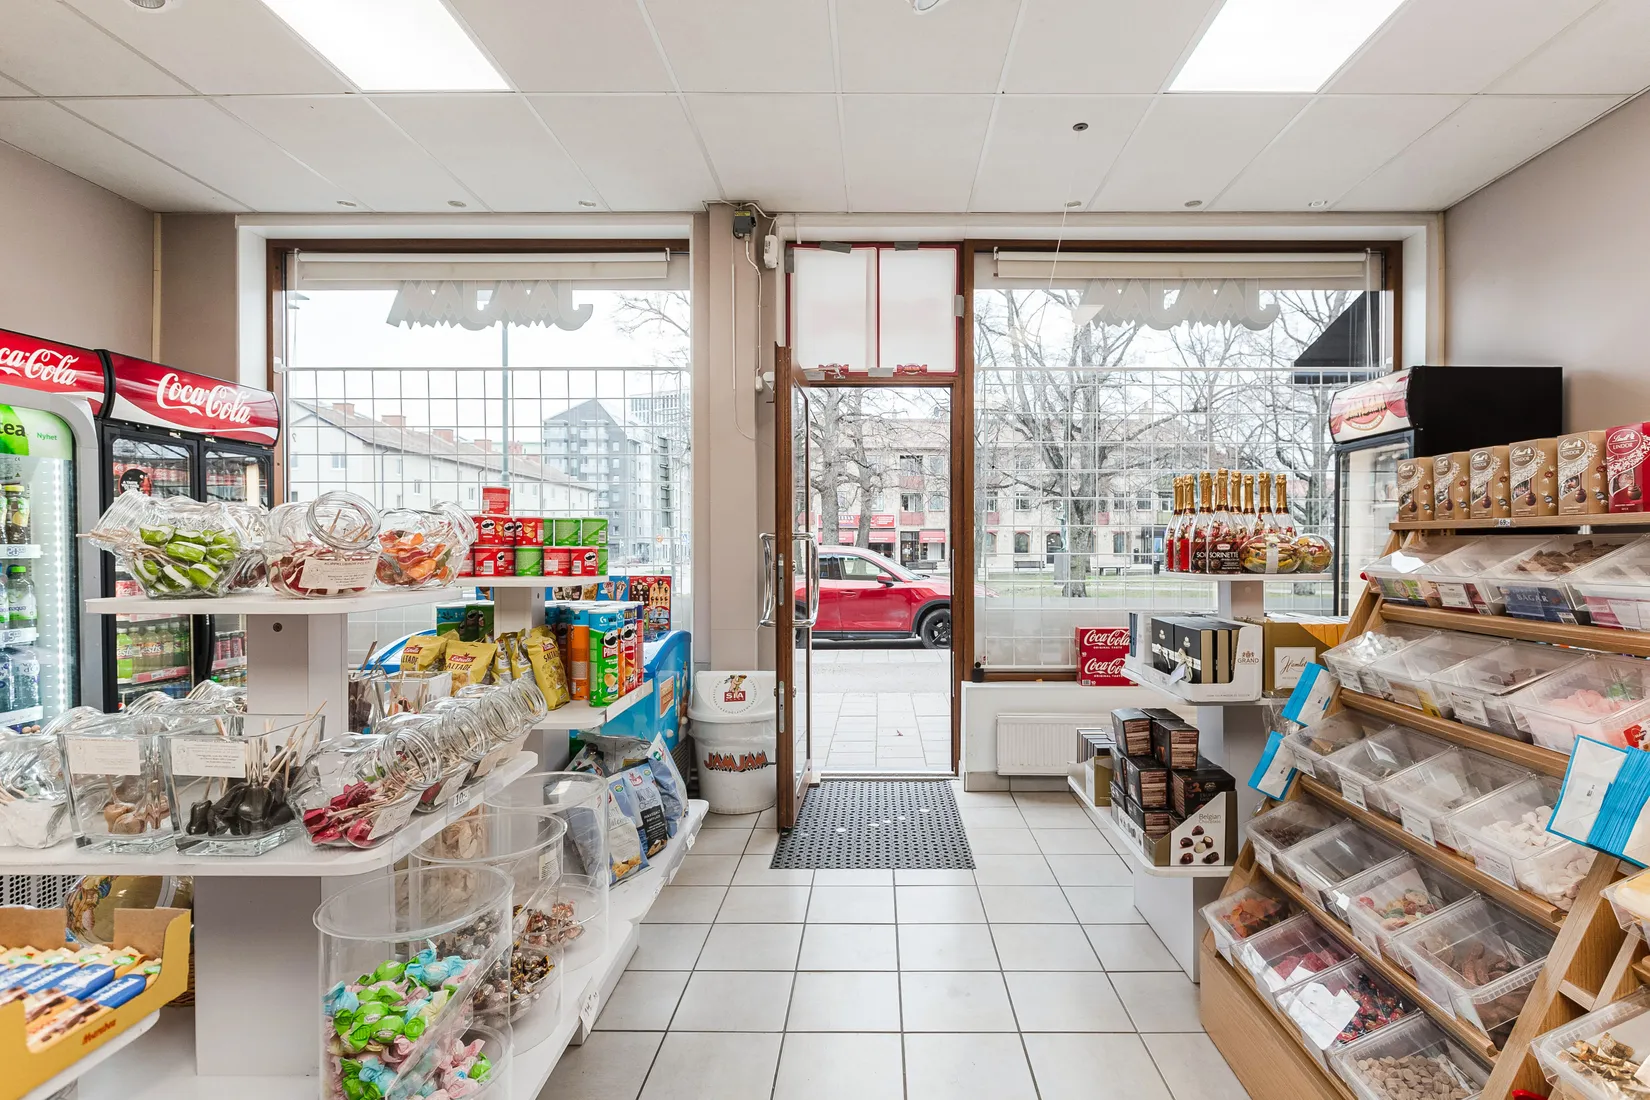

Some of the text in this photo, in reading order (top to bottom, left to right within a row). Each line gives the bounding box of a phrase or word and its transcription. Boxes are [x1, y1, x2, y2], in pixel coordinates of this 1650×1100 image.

[0, 347, 79, 387] ca-Cola
[156, 372, 251, 424] Coca-Cola
[36, 432, 58, 441] Nyhet
[1612, 442, 1633, 450] LINDOR
[1209, 551, 1239, 559] SORINETTE
[1084, 629, 1130, 646] Coca-Cola
[1085, 658, 1125, 675] Coca-Co
[725, 692, 744, 700] SIA
[1199, 813, 1222, 822] Belgian
